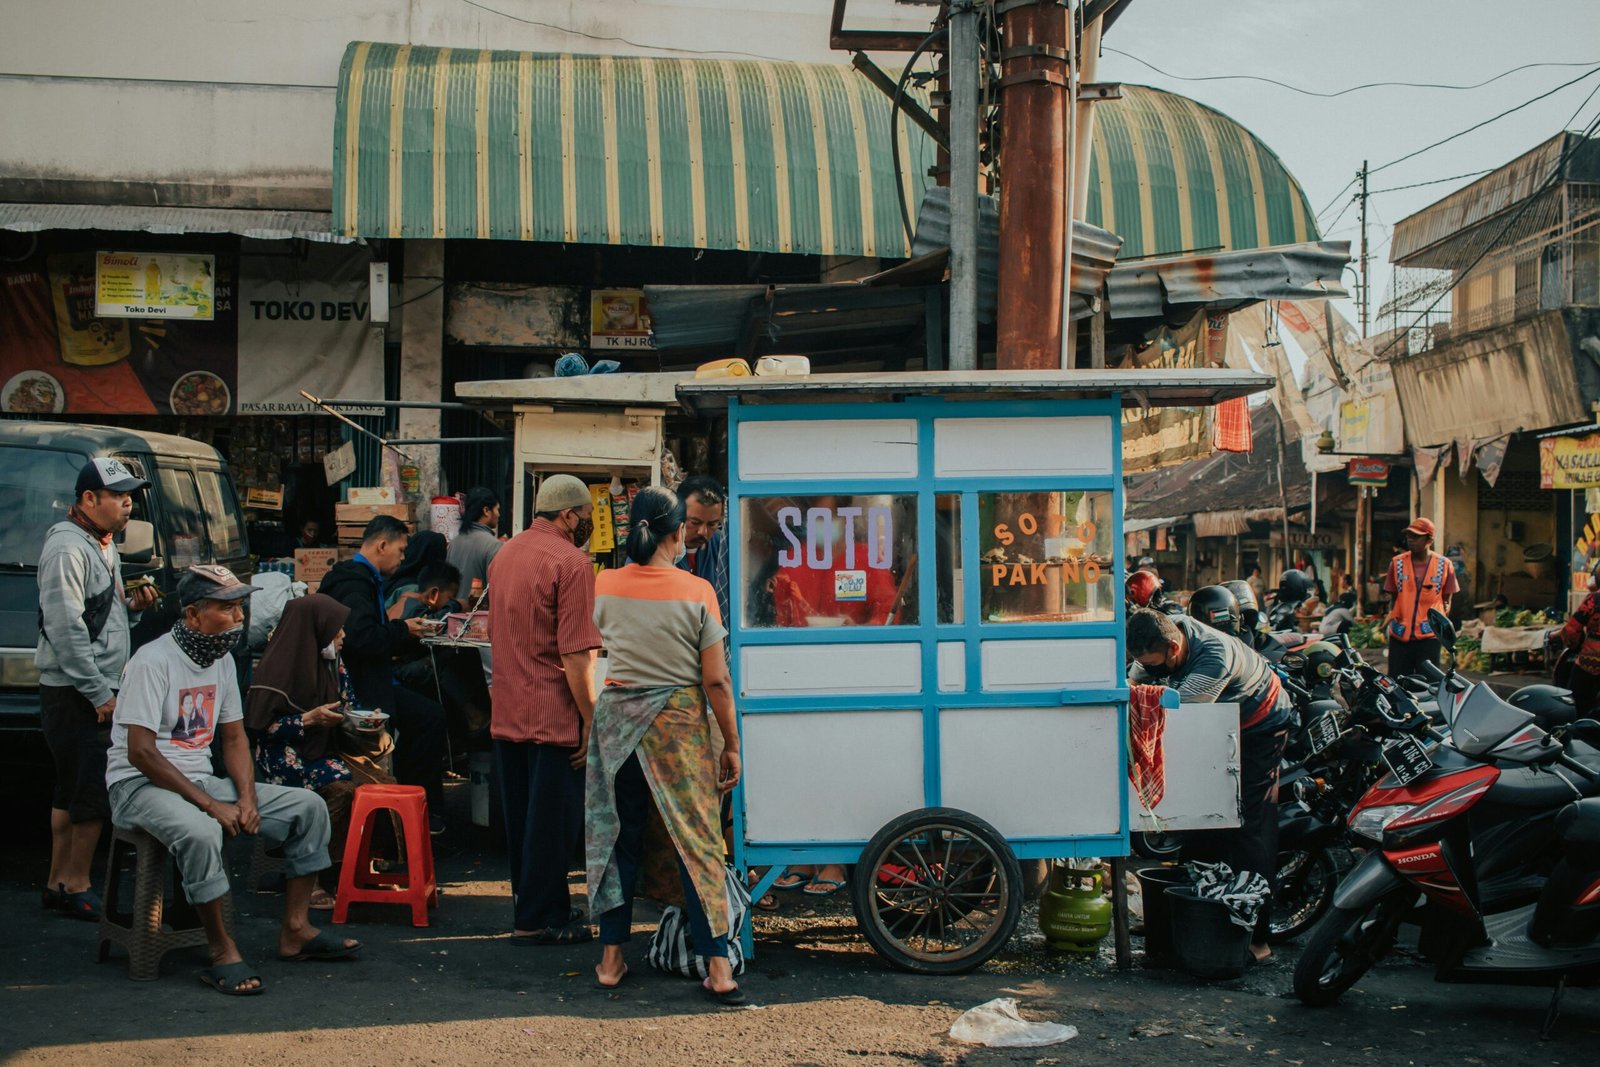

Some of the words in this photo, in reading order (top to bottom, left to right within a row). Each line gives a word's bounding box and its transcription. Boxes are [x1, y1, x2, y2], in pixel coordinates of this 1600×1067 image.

[103, 255, 139, 267] Bimoli
[125, 306, 145, 314] Toko
[148, 306, 167, 314] Devi
[250, 300, 316, 321] TOKO
[606, 337, 619, 346] TK
[624, 338, 638, 347] HJ
[241, 403, 276, 412] PASAR
[278, 403, 304, 412] RAYA
[994, 511, 1096, 547] SOTO
[777, 507, 893, 569] SOTO
[992, 562, 1048, 587] PAK
[1062, 560, 1100, 585] NO
[1397, 736, 1411, 749] K
[1402, 745, 1421, 763] 3164
[1397, 852, 1438, 865] HONDA
